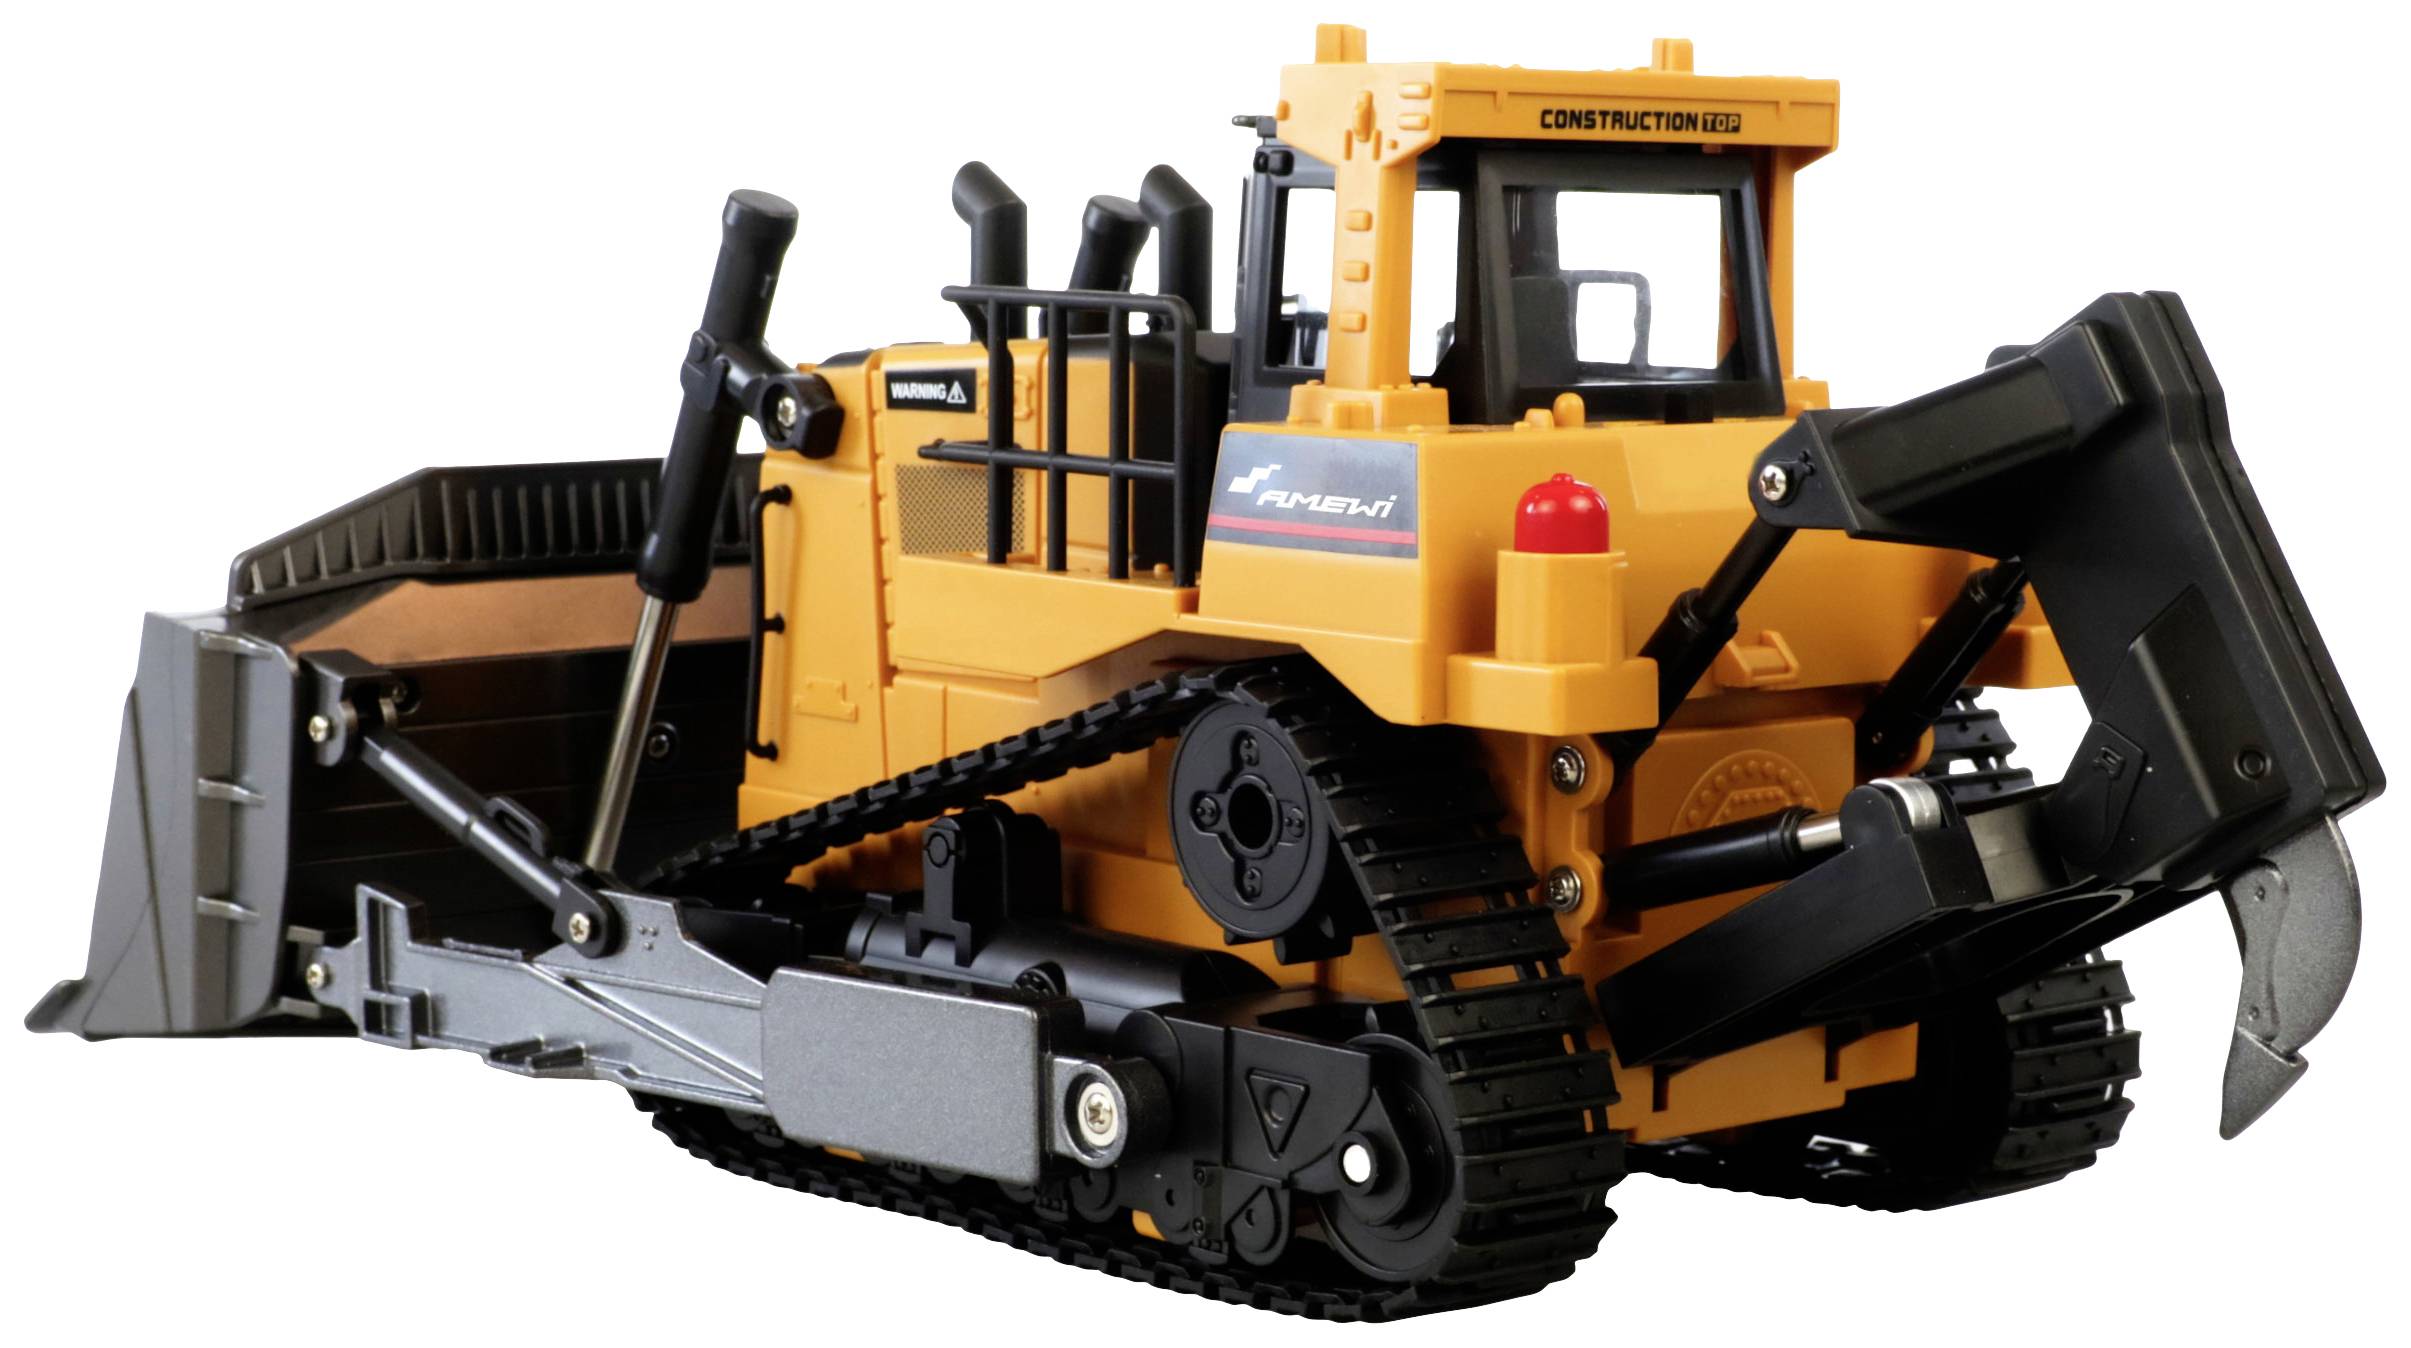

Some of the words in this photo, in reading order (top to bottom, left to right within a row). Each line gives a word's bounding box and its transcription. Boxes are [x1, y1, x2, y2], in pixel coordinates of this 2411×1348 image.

[1540, 109, 1698, 132] CONSTRUCTION
[1703, 113, 1740, 132] TOP
[890, 382, 947, 400] WARNING
